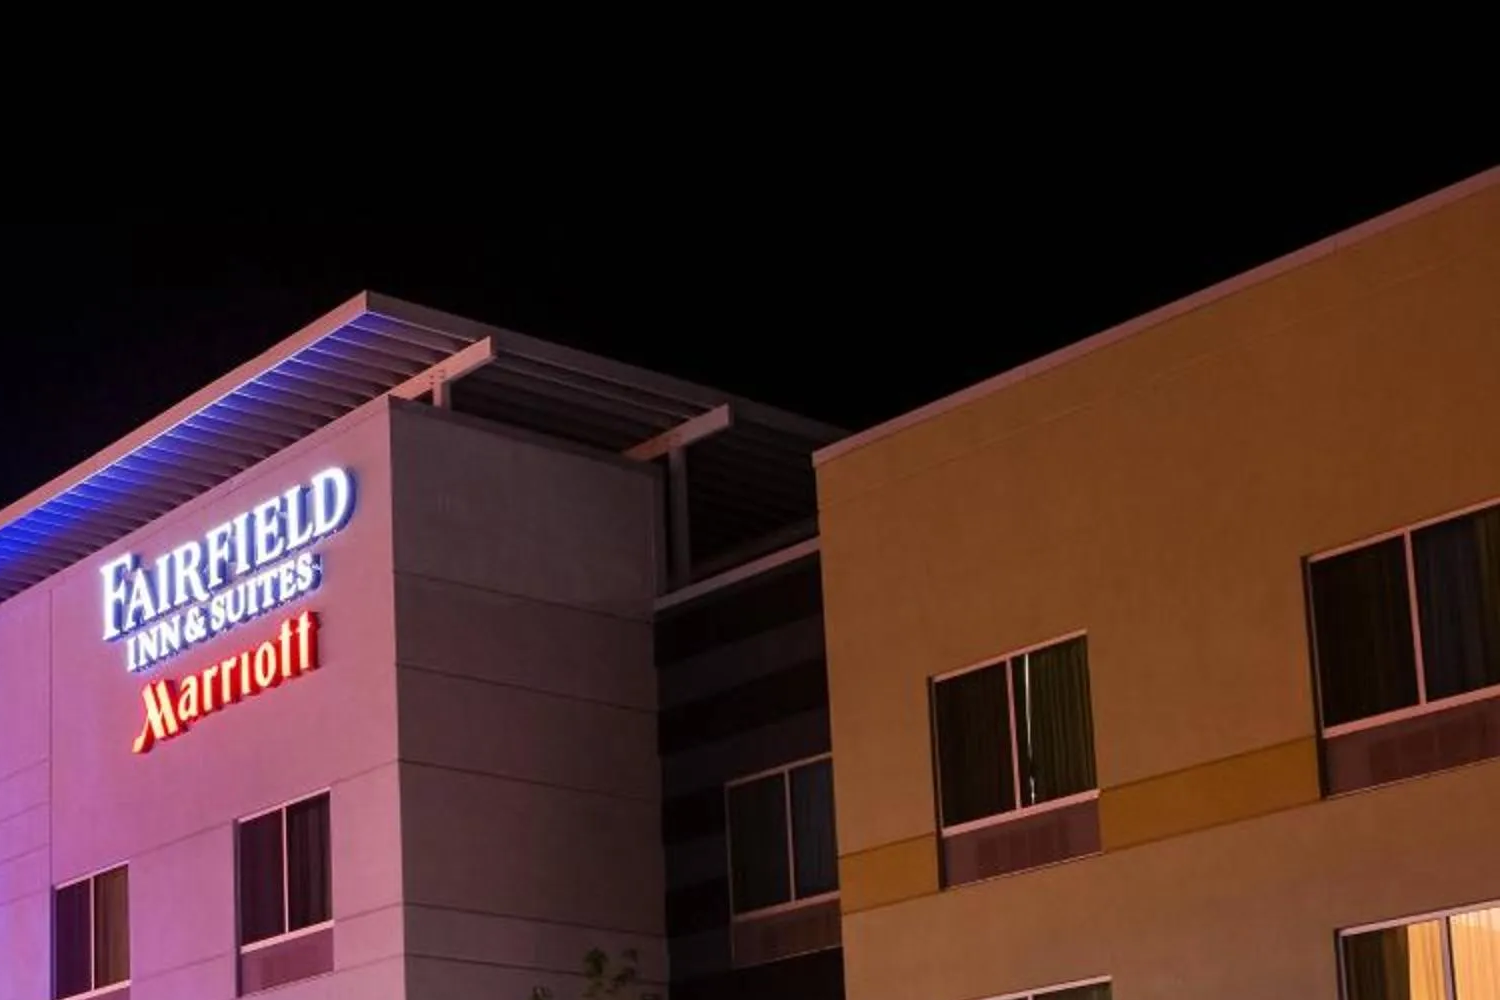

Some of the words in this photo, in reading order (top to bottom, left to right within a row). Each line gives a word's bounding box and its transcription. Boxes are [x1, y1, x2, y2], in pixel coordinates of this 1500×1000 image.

[99, 467, 355, 640] FAIRFIELD
[127, 615, 183, 672] INN
[184, 609, 208, 642] &
[210, 551, 321, 632] SUITES
[132, 611, 321, 753] Marriott
